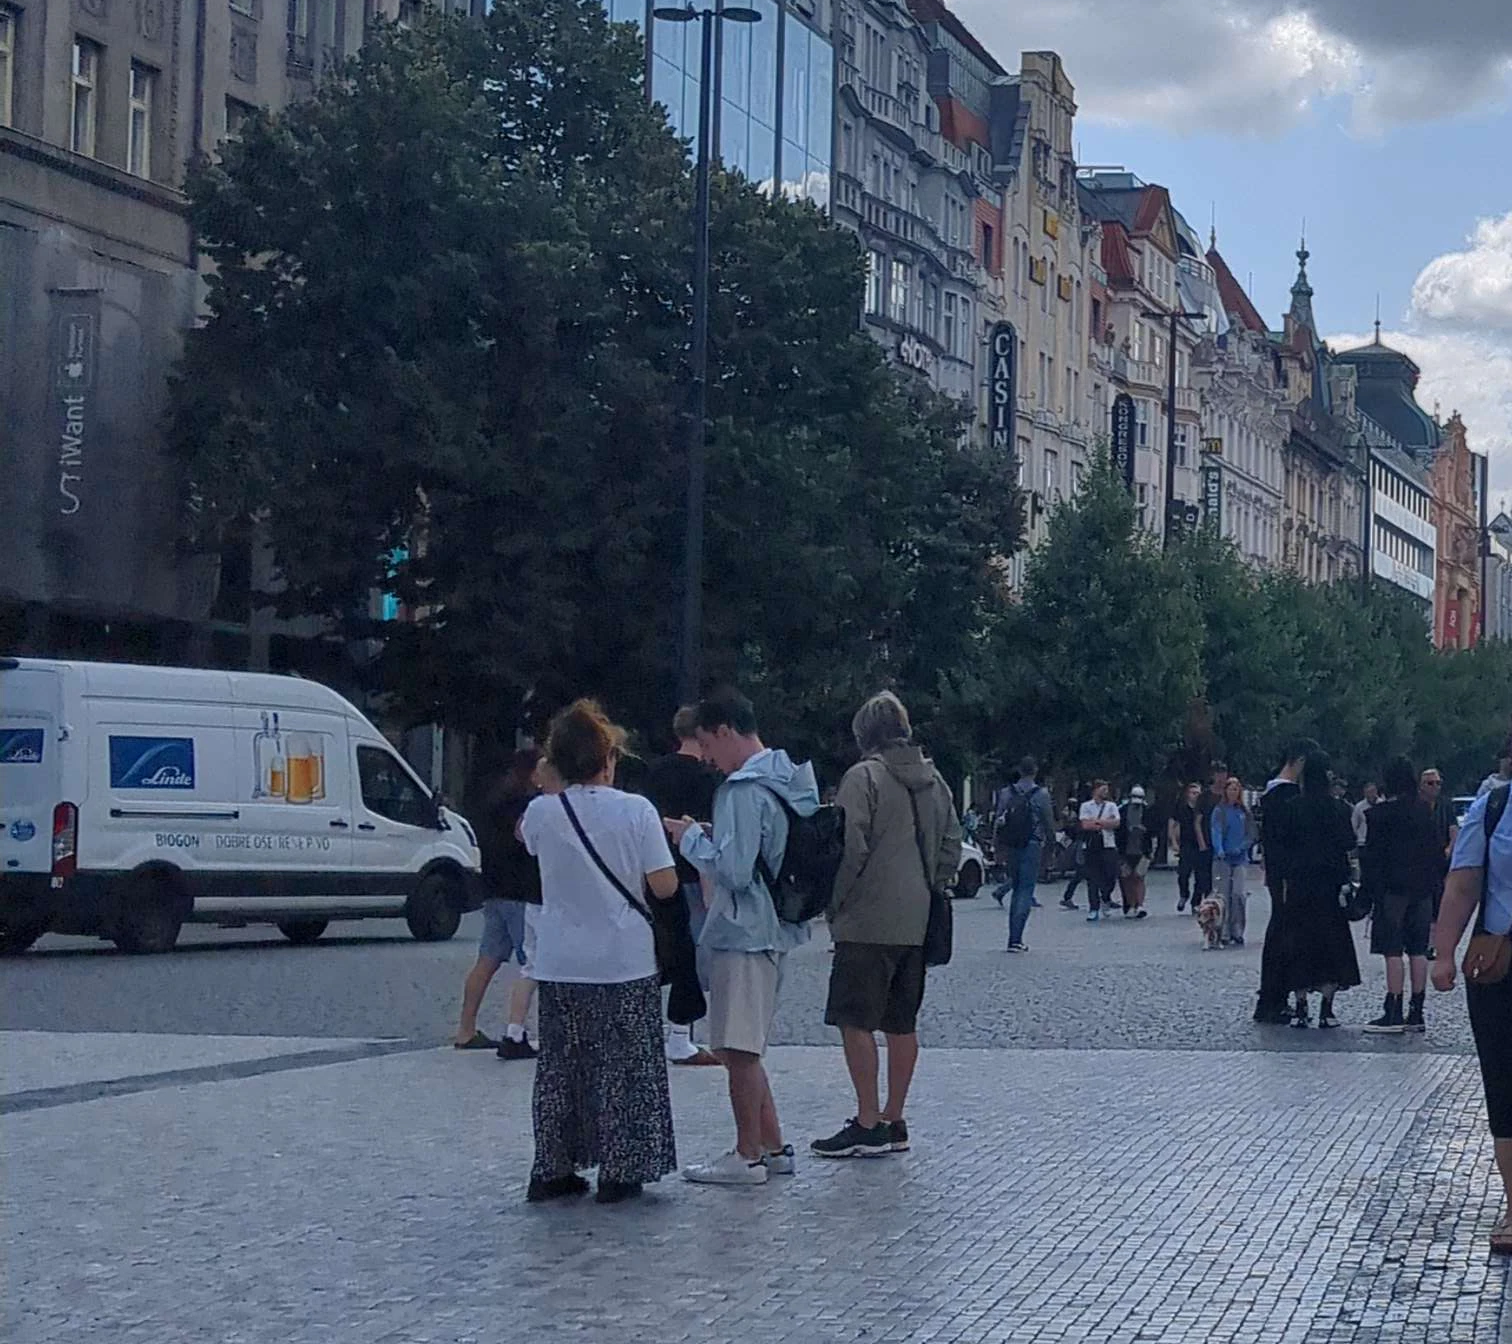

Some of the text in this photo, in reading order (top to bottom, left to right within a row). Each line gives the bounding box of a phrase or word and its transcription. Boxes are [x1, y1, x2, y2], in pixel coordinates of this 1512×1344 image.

[994, 333, 1010, 449] CASIN
[58, 395, 84, 466] iWant
[1207, 471, 1220, 516] nald's
[141, 766, 192, 786] Linde
[155, 833, 200, 848] BIOGON
